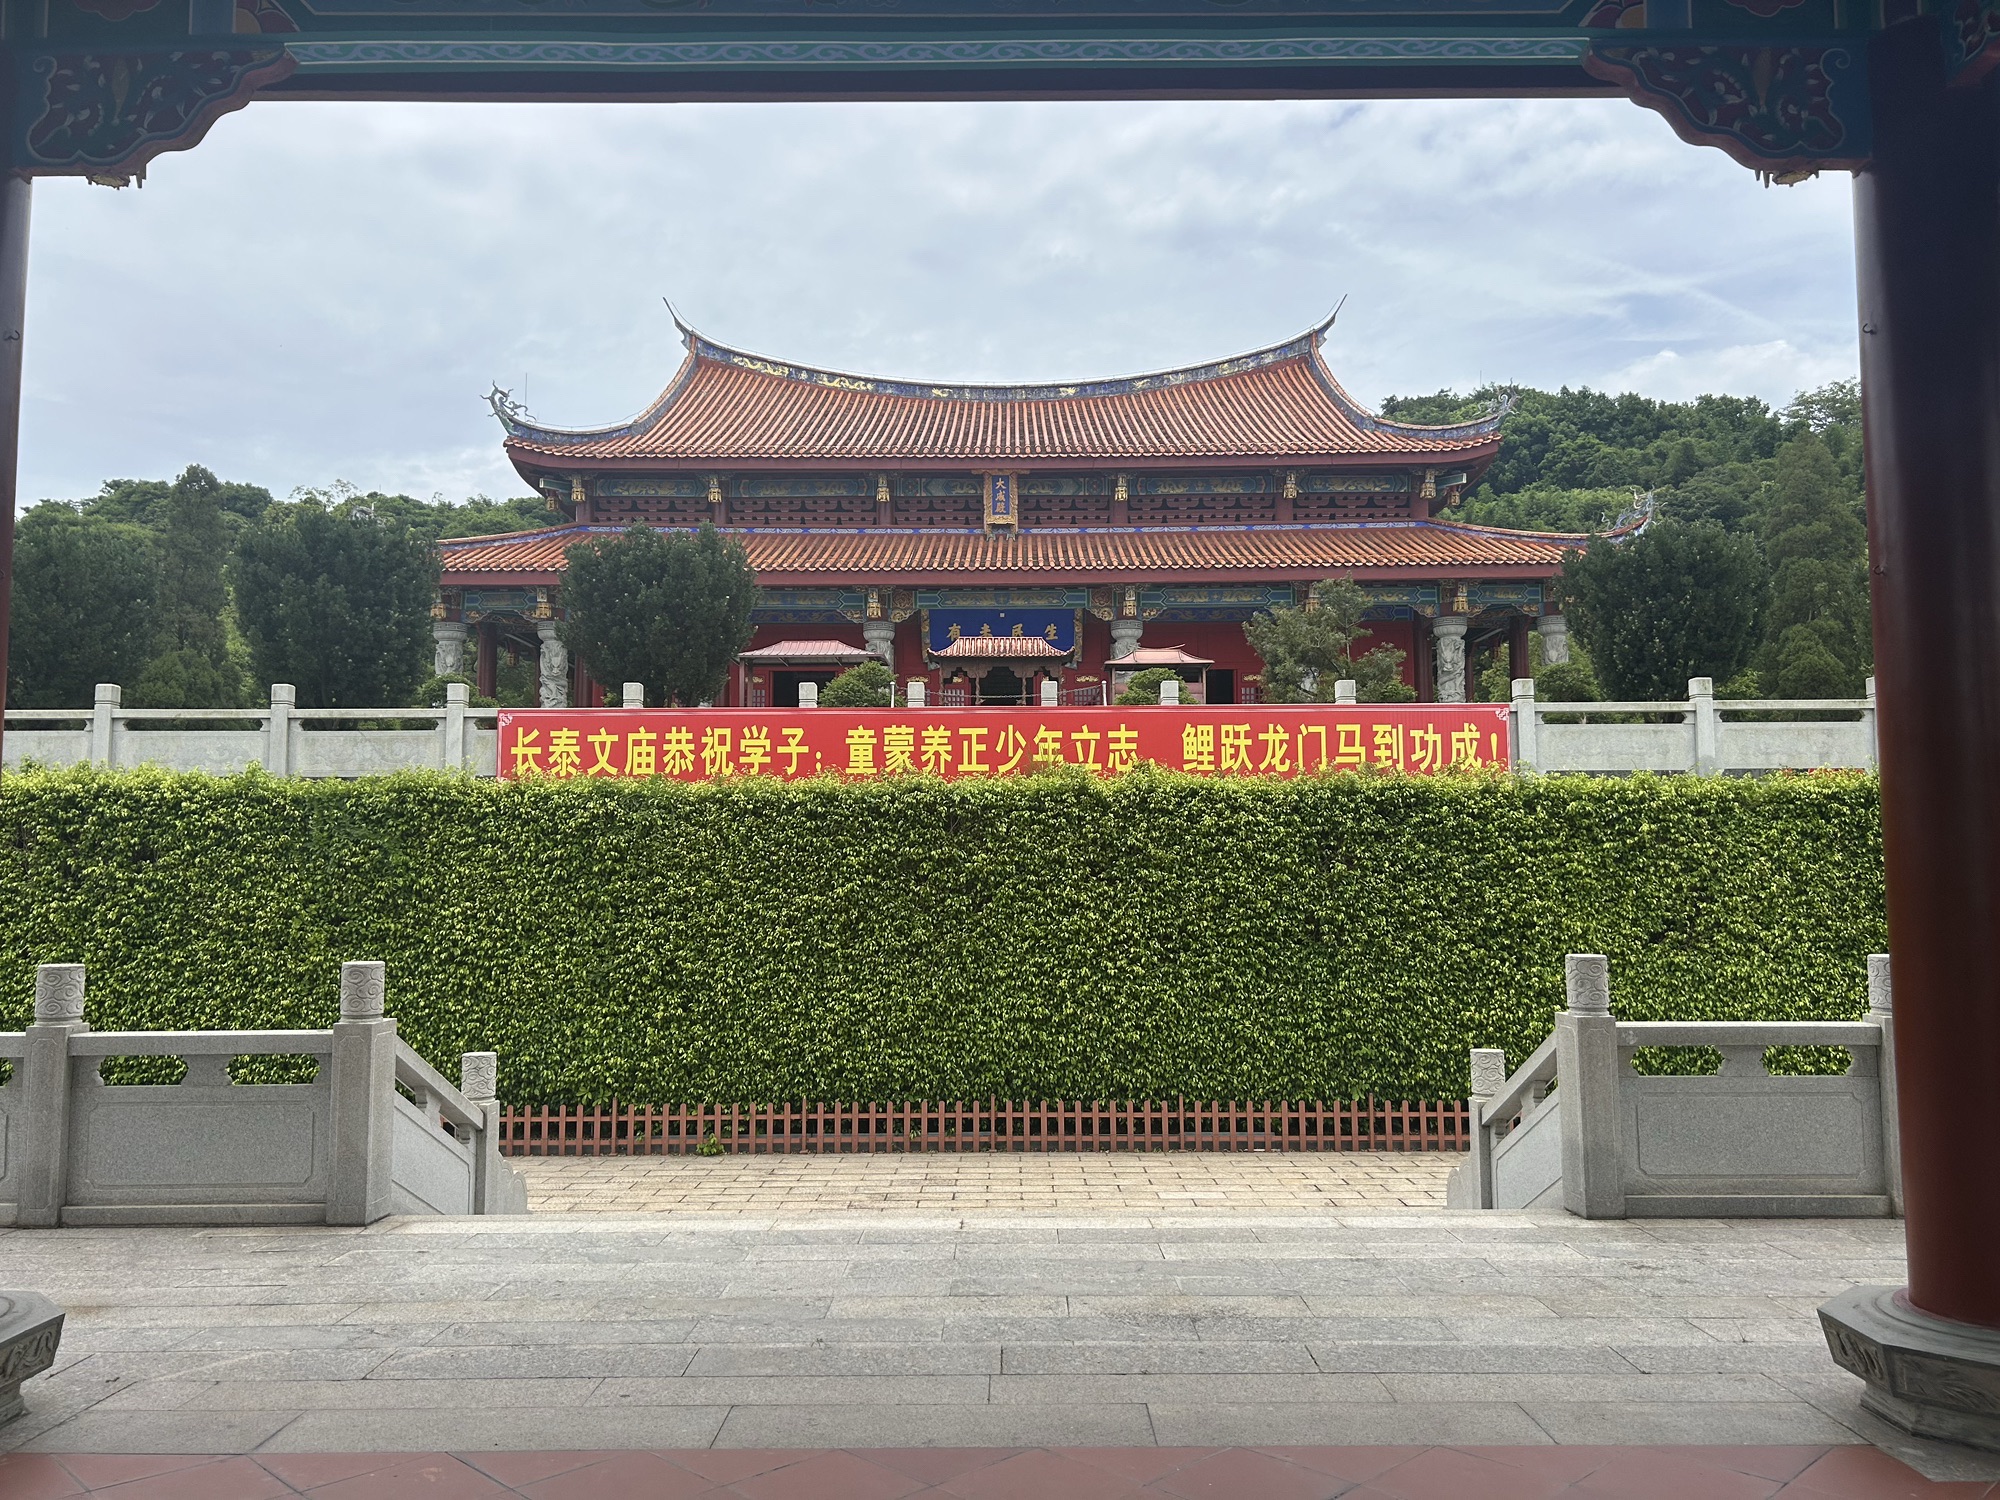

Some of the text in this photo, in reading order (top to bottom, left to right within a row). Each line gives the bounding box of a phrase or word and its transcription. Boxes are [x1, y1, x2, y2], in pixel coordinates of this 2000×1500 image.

[995, 477, 1007, 514] 大成殿
[510, 722, 1499, 777] 长泰文庙恭祝学子：童蒙养正少年立志鲤跃龙门马到功成！
